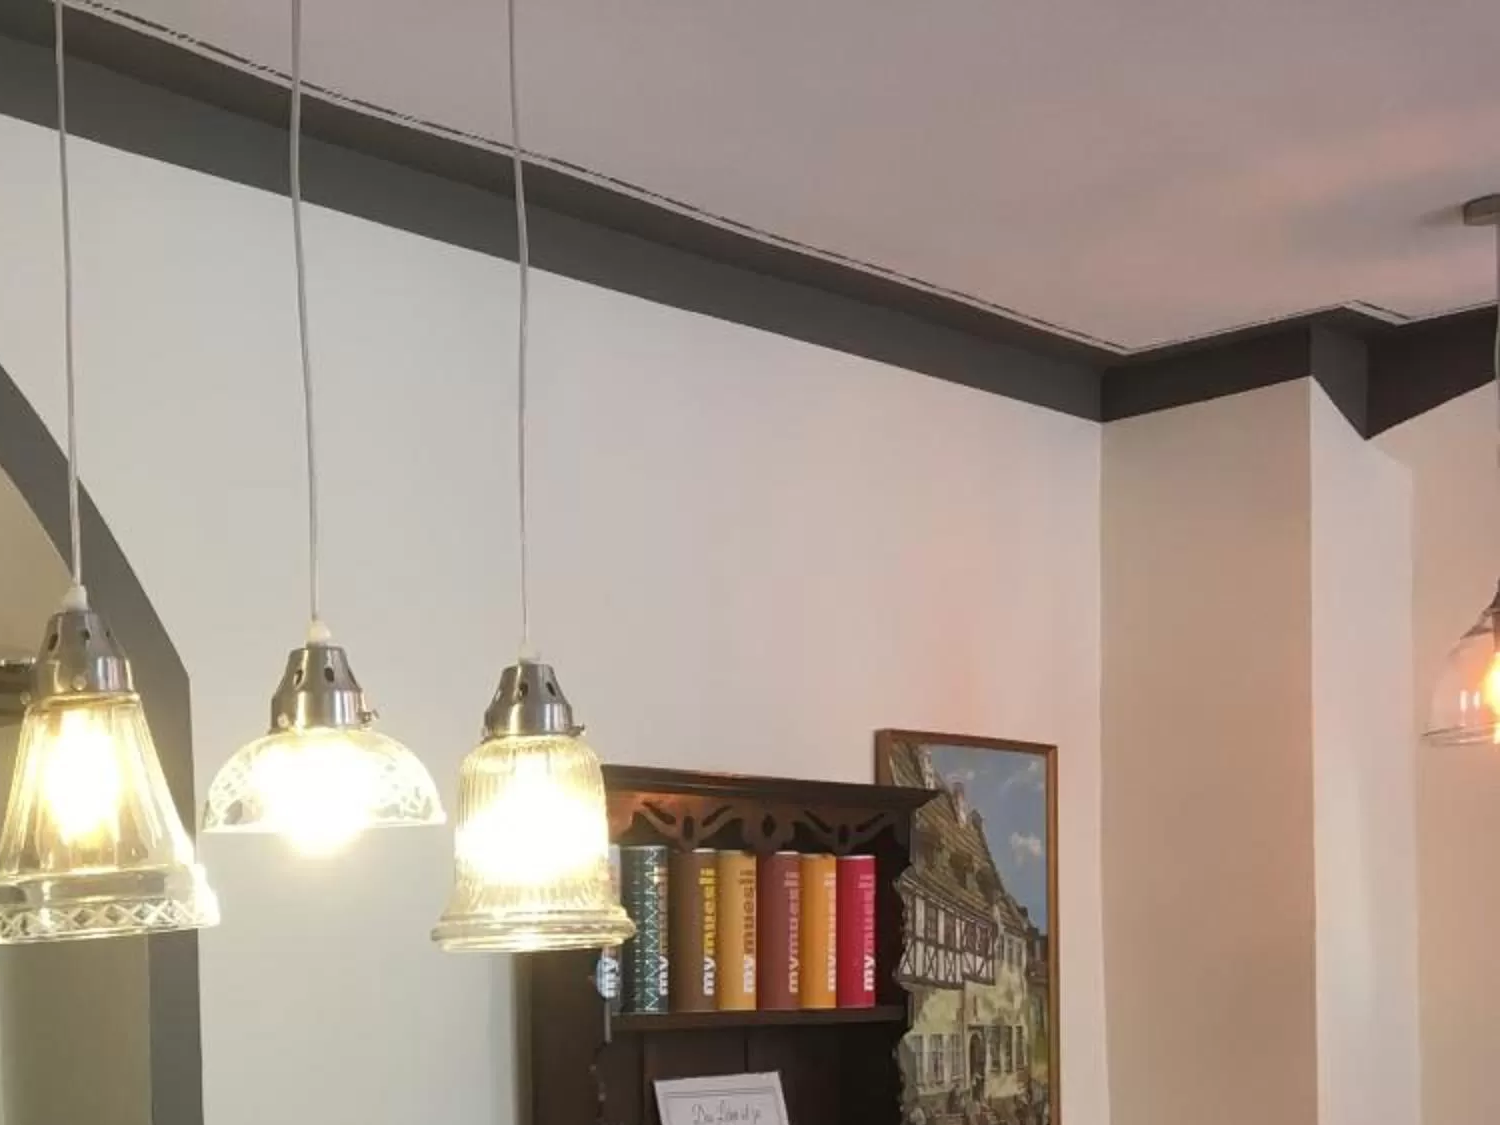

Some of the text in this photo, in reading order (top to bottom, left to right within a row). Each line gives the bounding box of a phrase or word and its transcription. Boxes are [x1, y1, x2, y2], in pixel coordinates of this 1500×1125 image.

[700, 868, 716, 996] mymuesli
[739, 870, 756, 993] mymuesli
[784, 872, 799, 993] mymuesli
